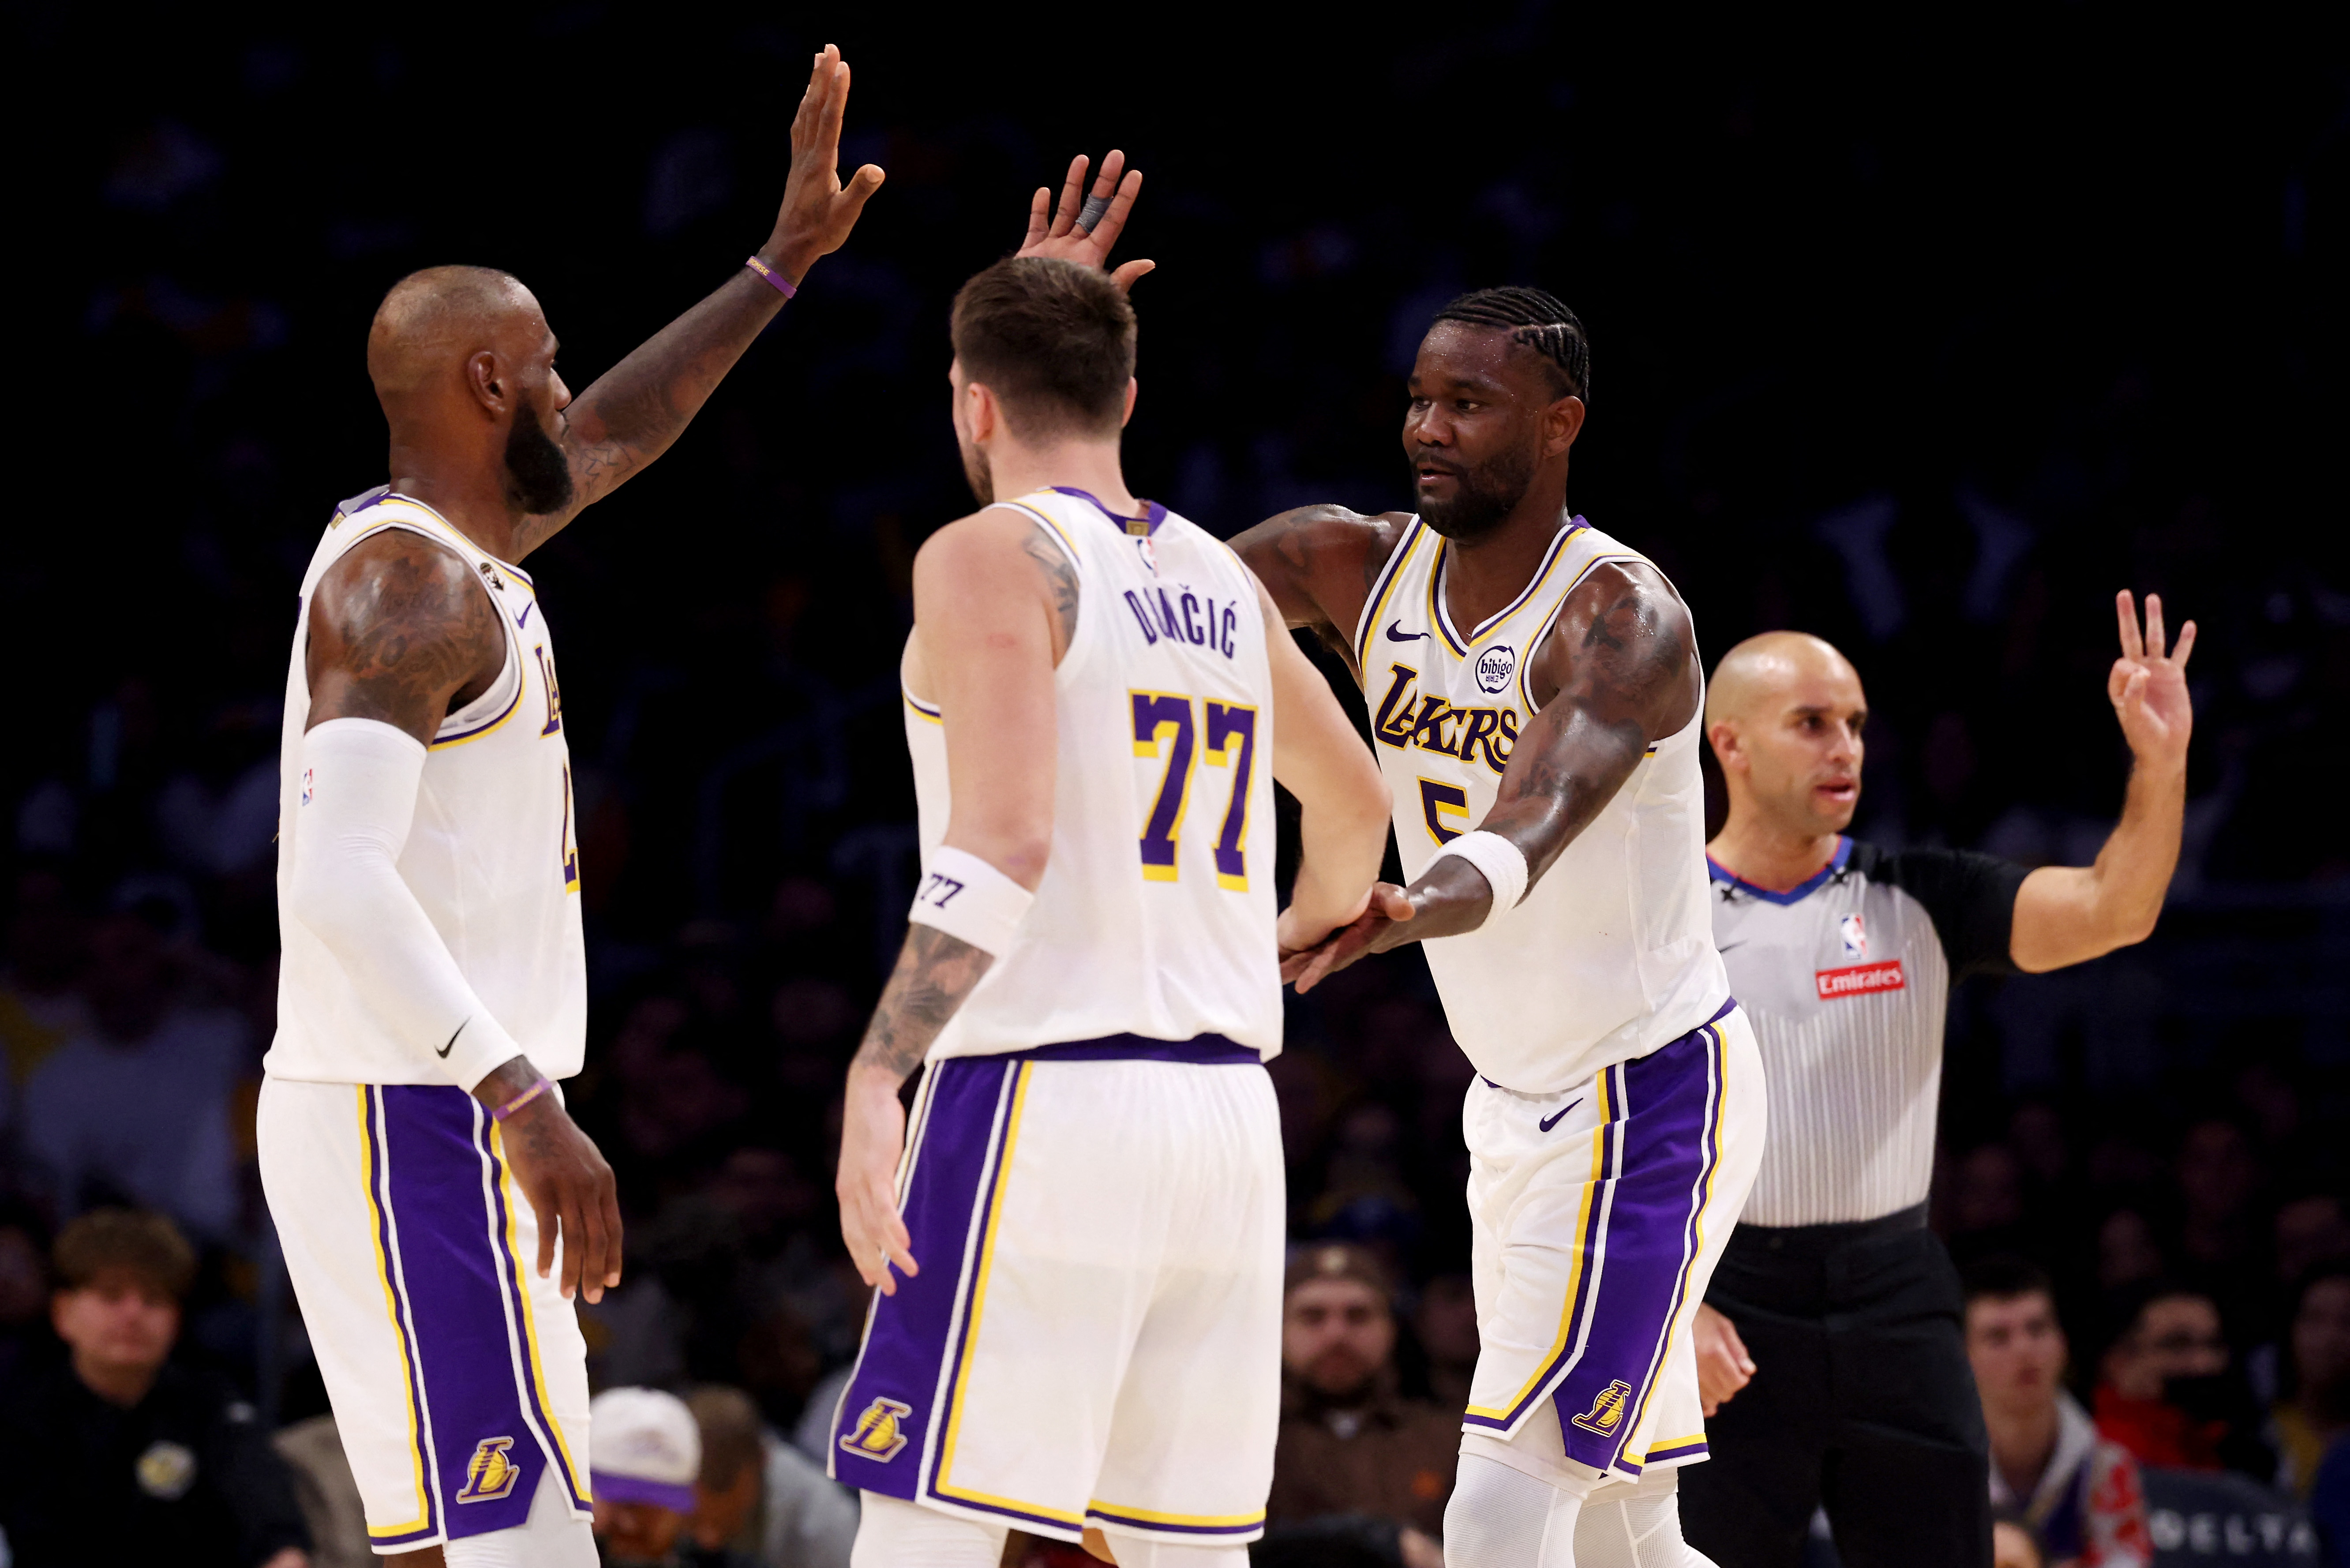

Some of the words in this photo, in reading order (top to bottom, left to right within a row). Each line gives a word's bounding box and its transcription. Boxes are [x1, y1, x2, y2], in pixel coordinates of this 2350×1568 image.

[1480, 658, 1512, 679] bibigo
[1375, 661, 1519, 776] LAKERS
[1128, 689, 1258, 893] 77
[921, 873, 964, 909] 77
[1818, 967, 1901, 994] Emirates
